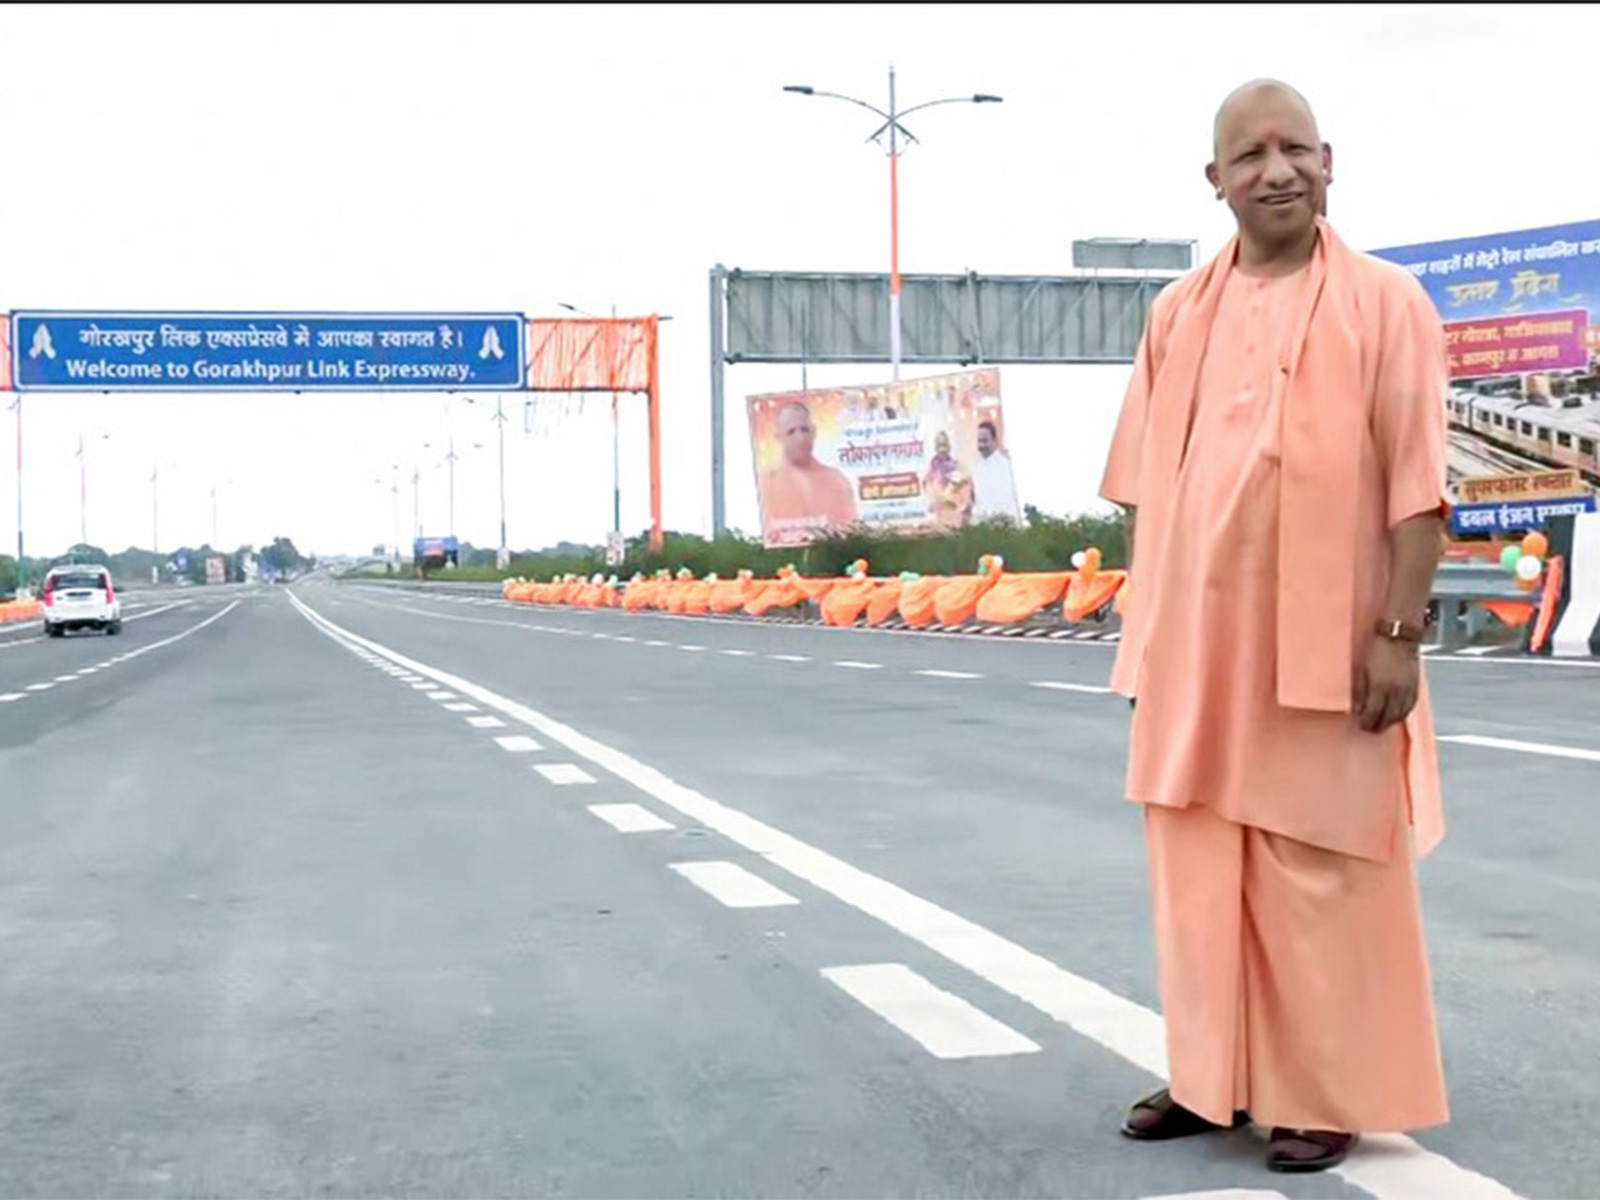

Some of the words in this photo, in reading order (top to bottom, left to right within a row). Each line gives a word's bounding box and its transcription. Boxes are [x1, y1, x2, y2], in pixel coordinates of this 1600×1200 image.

[79, 323, 155, 355] गोरखपुर
[205, 323, 289, 349] एक्सप्रेसवे
[293, 323, 310, 347] में
[317, 330, 374, 348] आपका
[378, 330, 436, 348] स्वागत
[66, 359, 163, 378] Welcome
[166, 362, 190, 378] to
[193, 358, 303, 382] Gorakhpur
[307, 359, 350, 378] Link
[355, 359, 477, 382] Expressway.
